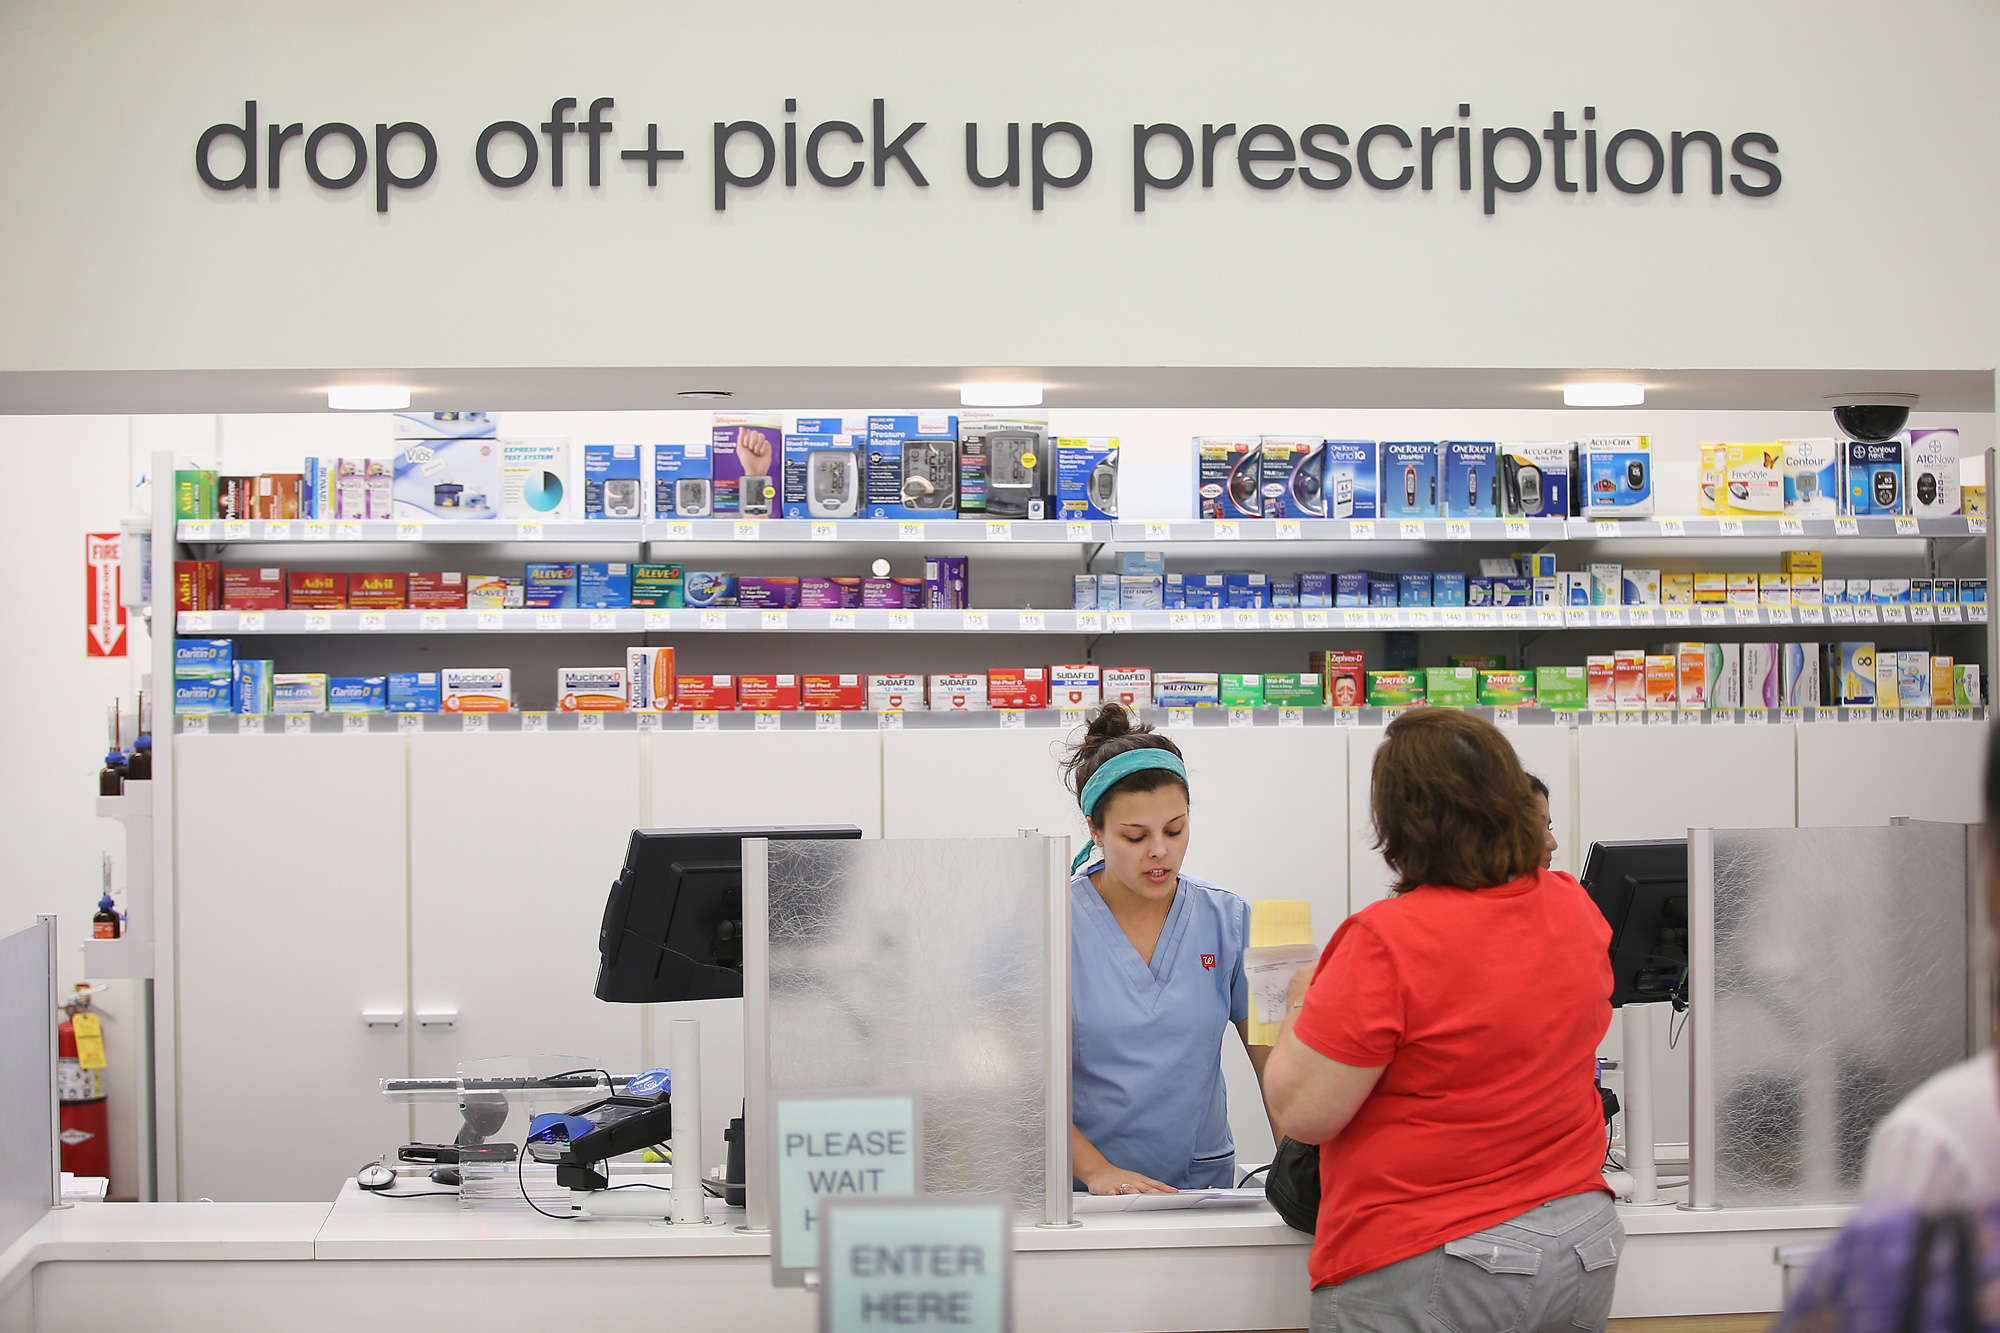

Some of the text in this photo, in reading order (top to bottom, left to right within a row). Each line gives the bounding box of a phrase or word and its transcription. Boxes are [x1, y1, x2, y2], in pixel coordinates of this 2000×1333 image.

[195, 100, 438, 213] drop
[714, 98, 930, 211] pick
[965, 121, 1094, 211] up
[1133, 103, 1783, 214] prescriptions
[1389, 444, 1430, 454] ONETOUCH
[1452, 444, 1493, 453] ONETOUCH
[1786, 457, 1825, 466] Contour
[1732, 470, 1768, 480] FreeStyle
[92, 545, 119, 559] FIRE
[530, 569, 574, 579] ALEVE-D
[636, 568, 680, 579] ALEVE-D
[302, 578, 334, 588] Advil
[361, 579, 394, 589] Advil
[472, 589, 515, 597] ALAVERT
[1376, 675, 1416, 684] ZYRTEC-D
[1487, 674, 1526, 683] ZYRTEC-D
[785, 1130, 908, 1157] PLEASE
[807, 1168, 885, 1194] WAIT
[850, 1244, 986, 1278] ENTER
[860, 1291, 974, 1325] HERE
